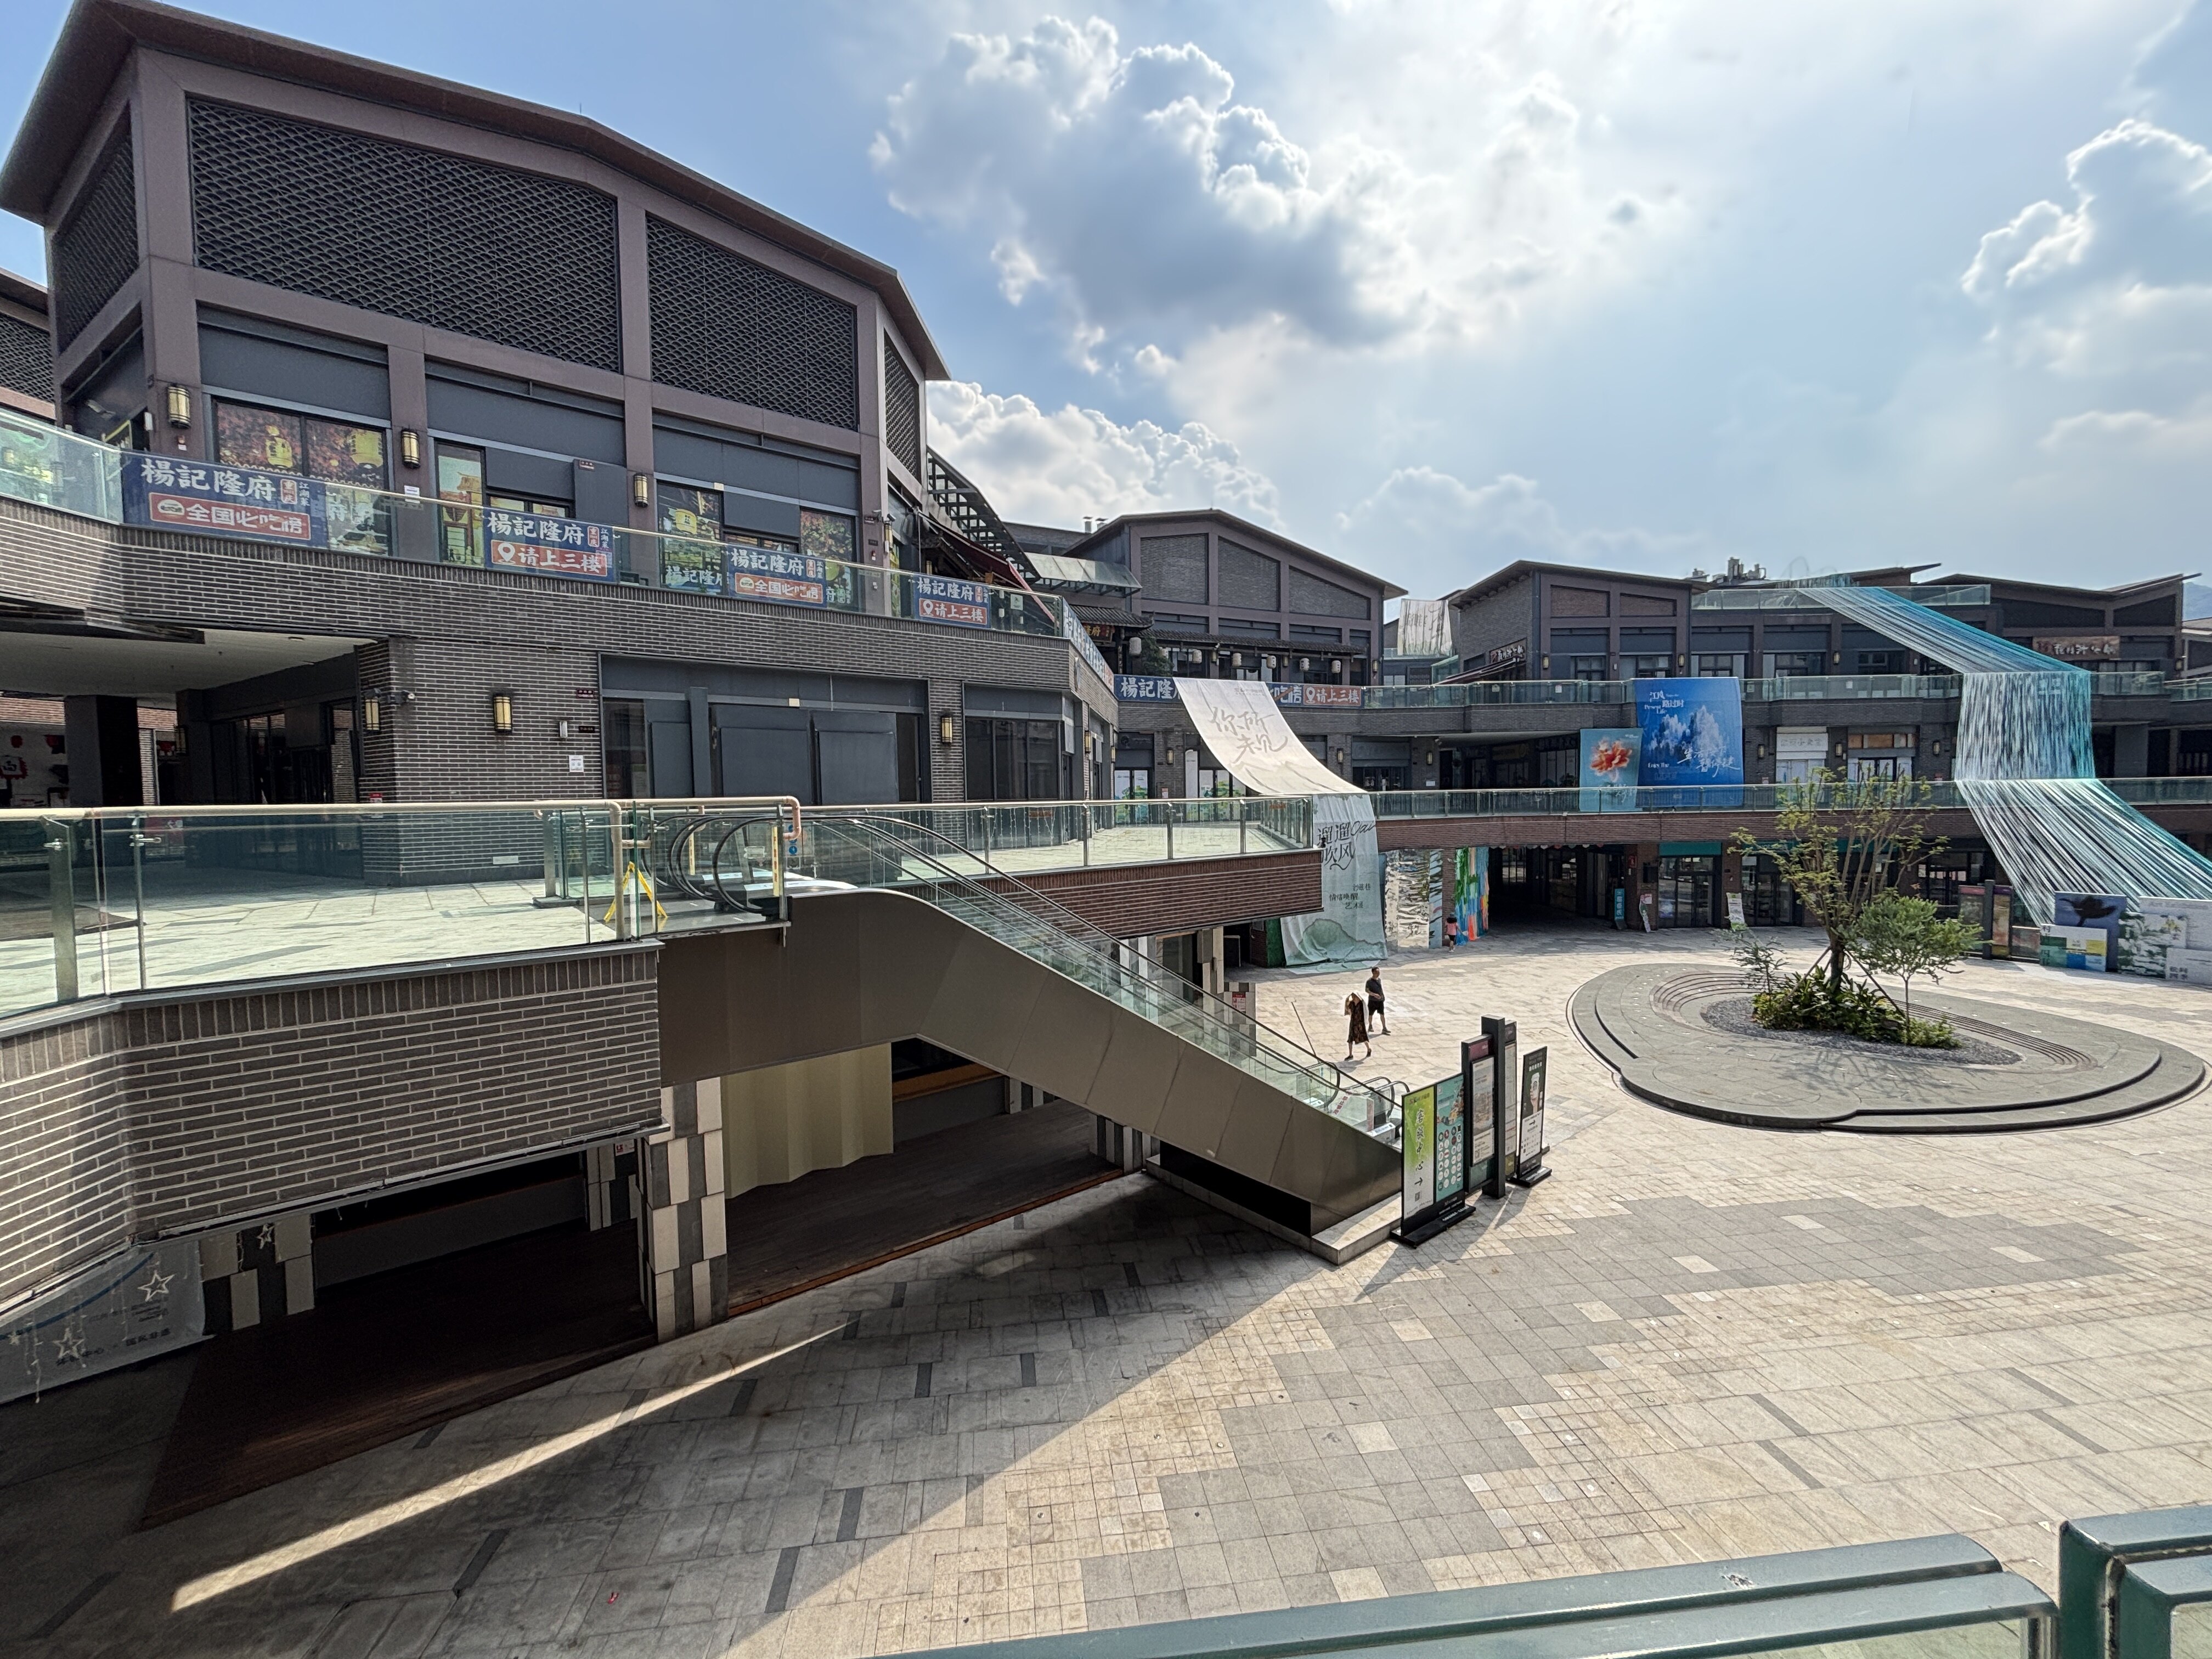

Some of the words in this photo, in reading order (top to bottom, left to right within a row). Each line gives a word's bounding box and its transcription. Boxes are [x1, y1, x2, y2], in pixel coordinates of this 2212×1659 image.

[141, 458, 276, 501] 楊記隆府
[186, 504, 302, 534] 全国必吃榜
[487, 511, 585, 545] 楊記隆府
[517, 547, 602, 574] 请上三楼
[730, 548, 804, 577] 楊記隆府
[754, 581, 819, 600] 全国必吃榜
[917, 577, 974, 602] 楊記隆府
[934, 603, 984, 623] 请上三楼
[1269, 685, 1302, 704] 吃榜
[1316, 688, 1359, 704] 请上三楼
